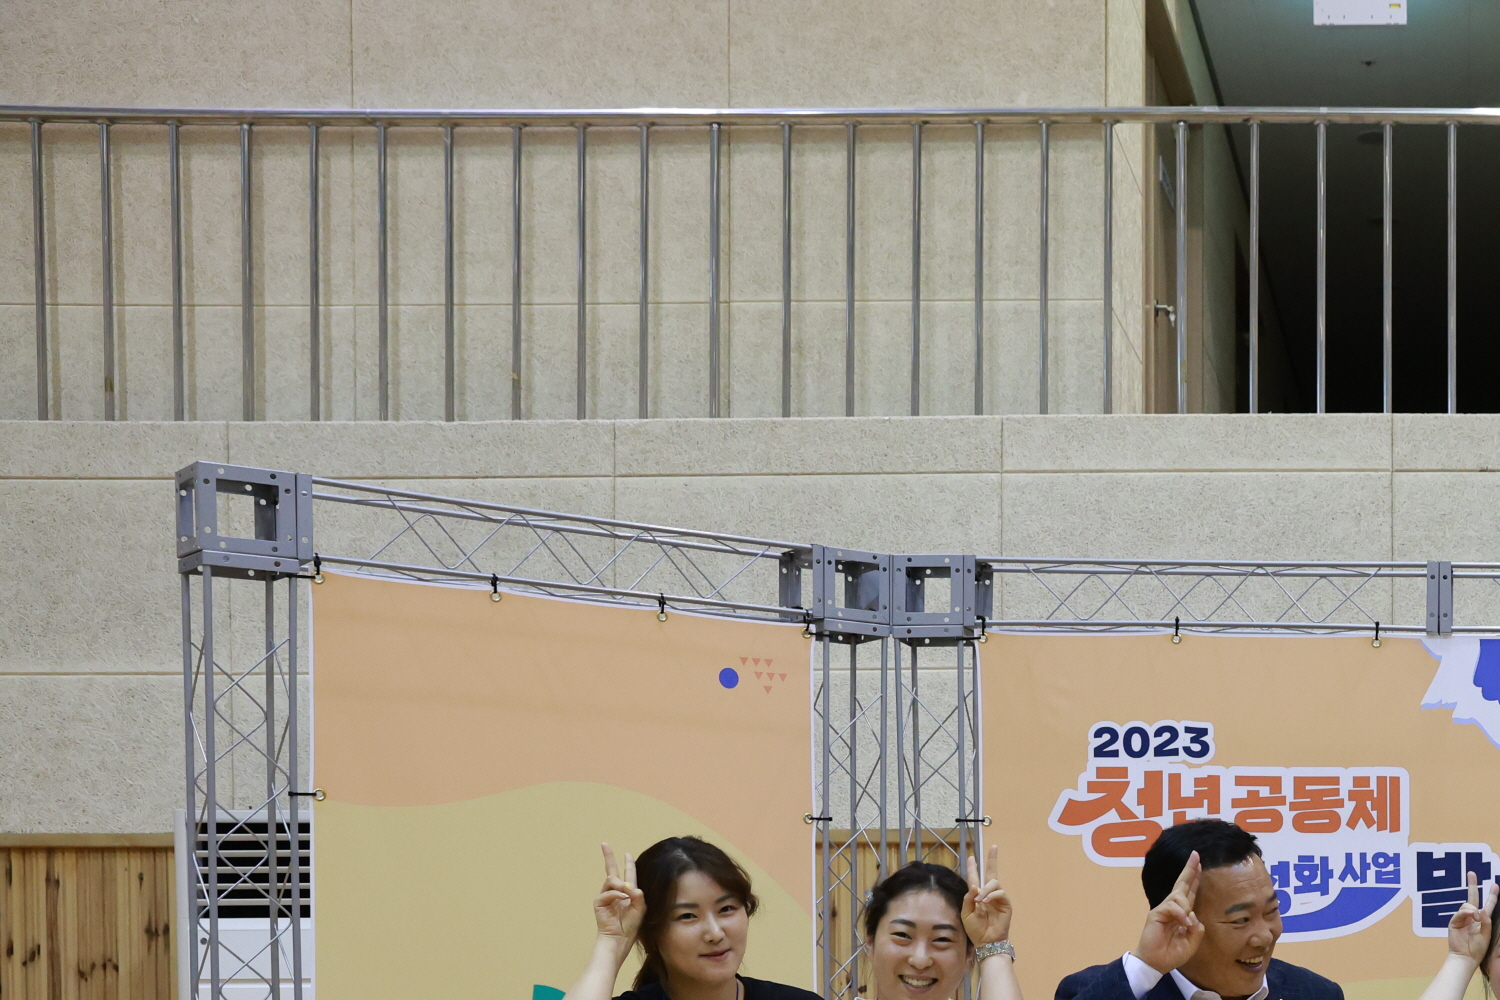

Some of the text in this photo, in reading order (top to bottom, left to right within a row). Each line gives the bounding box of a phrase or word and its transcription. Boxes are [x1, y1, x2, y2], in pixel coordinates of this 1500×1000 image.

[1093, 725, 1211, 759] 2023
[1057, 766, 1401, 858] 청년공동체
[1338, 852, 1401, 885] 사업
